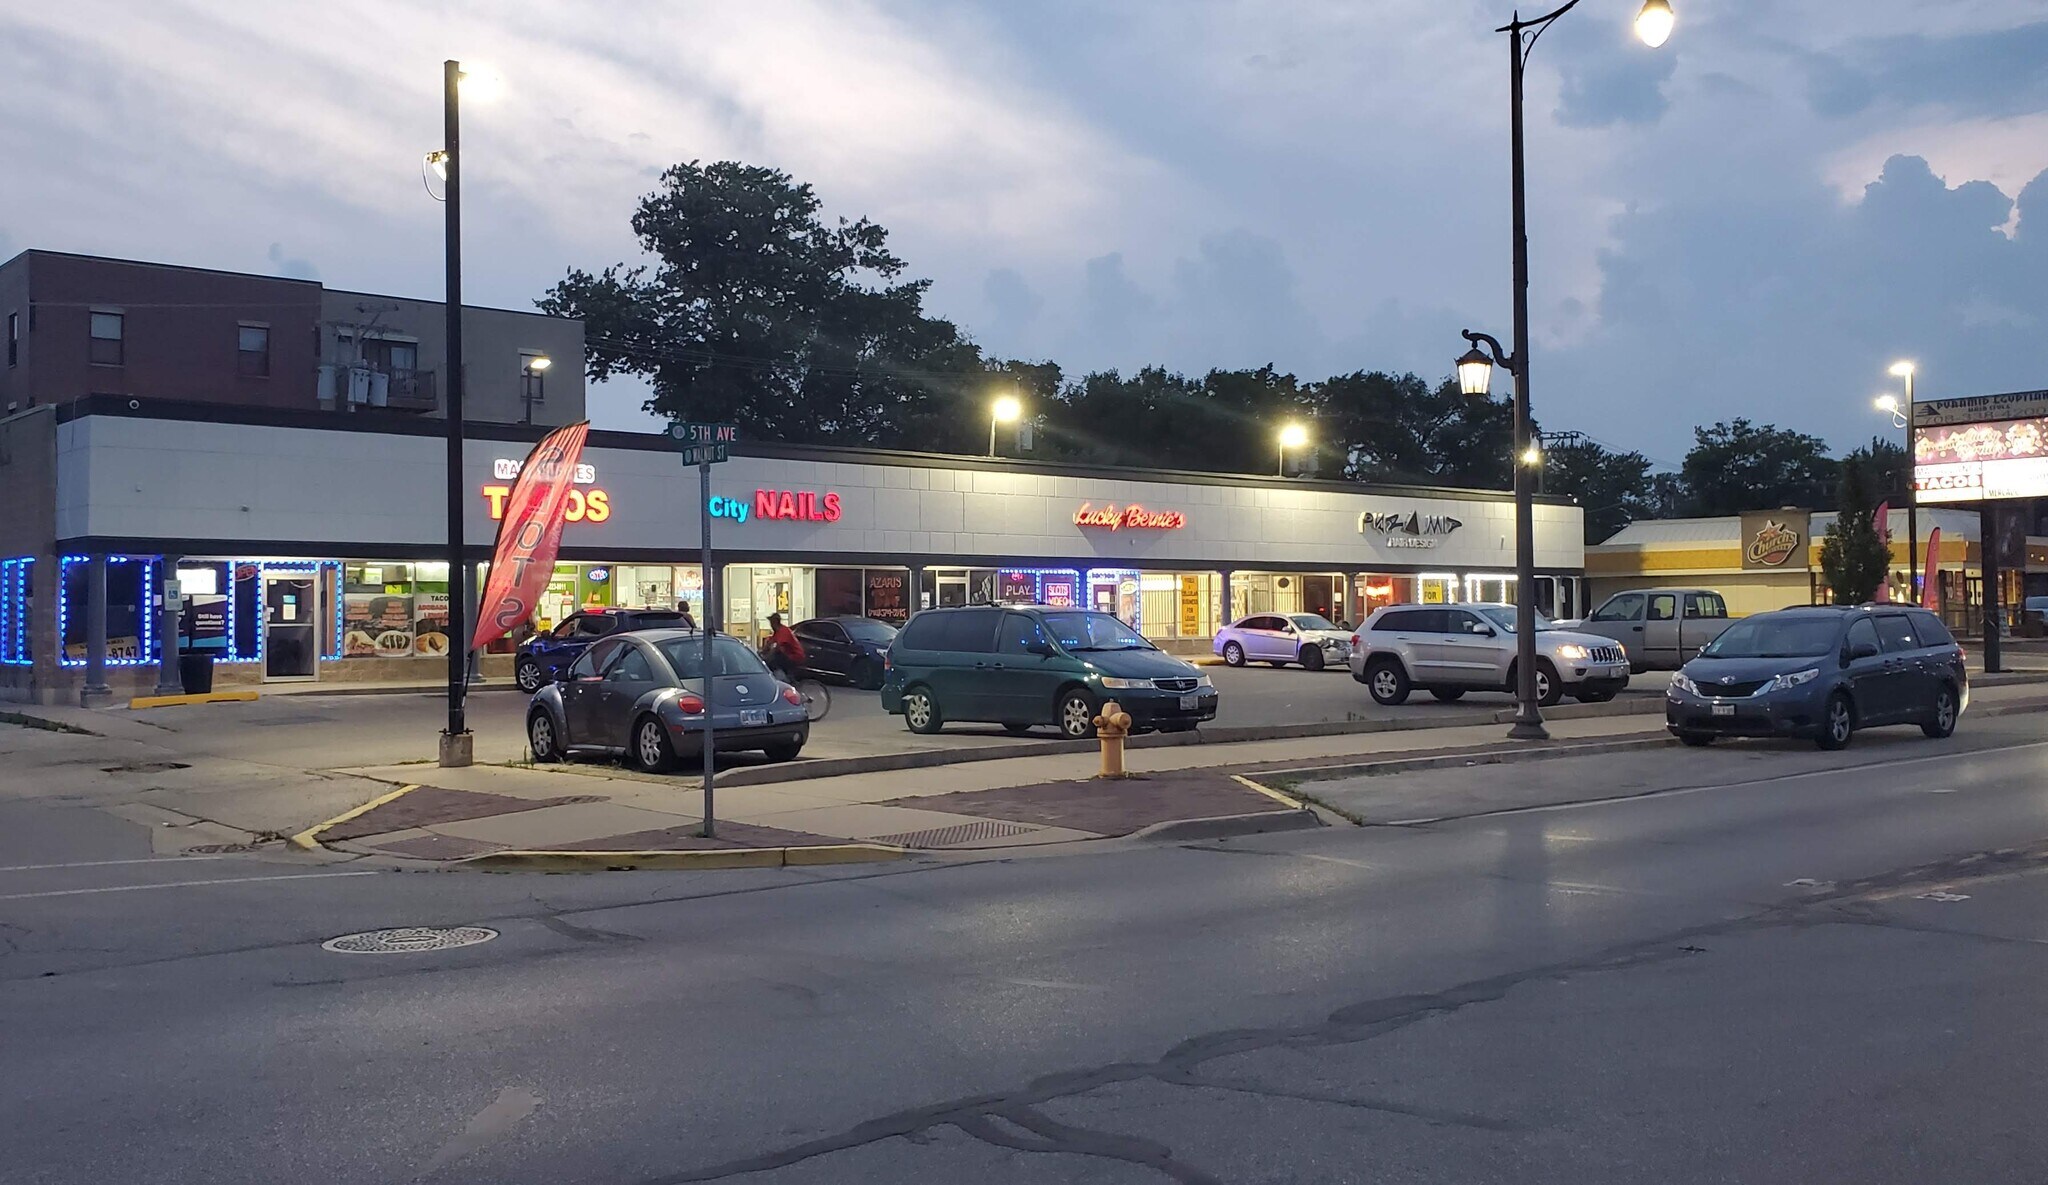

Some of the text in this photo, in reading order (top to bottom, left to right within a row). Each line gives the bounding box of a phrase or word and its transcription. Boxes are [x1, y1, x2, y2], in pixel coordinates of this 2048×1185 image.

[690, 425, 737, 441] 5TH AVE
[717, 445, 725, 460] ST
[1914, 474, 1981, 490] TACOS
[482, 485, 612, 522] TOS
[709, 488, 842, 523] City NAILS
[1072, 502, 1188, 532] Lucky Bernie's
[1006, 585, 1031, 595] PLAY
[1048, 585, 1068, 596] SLOTS
[1424, 591, 1437, 600] FOR
